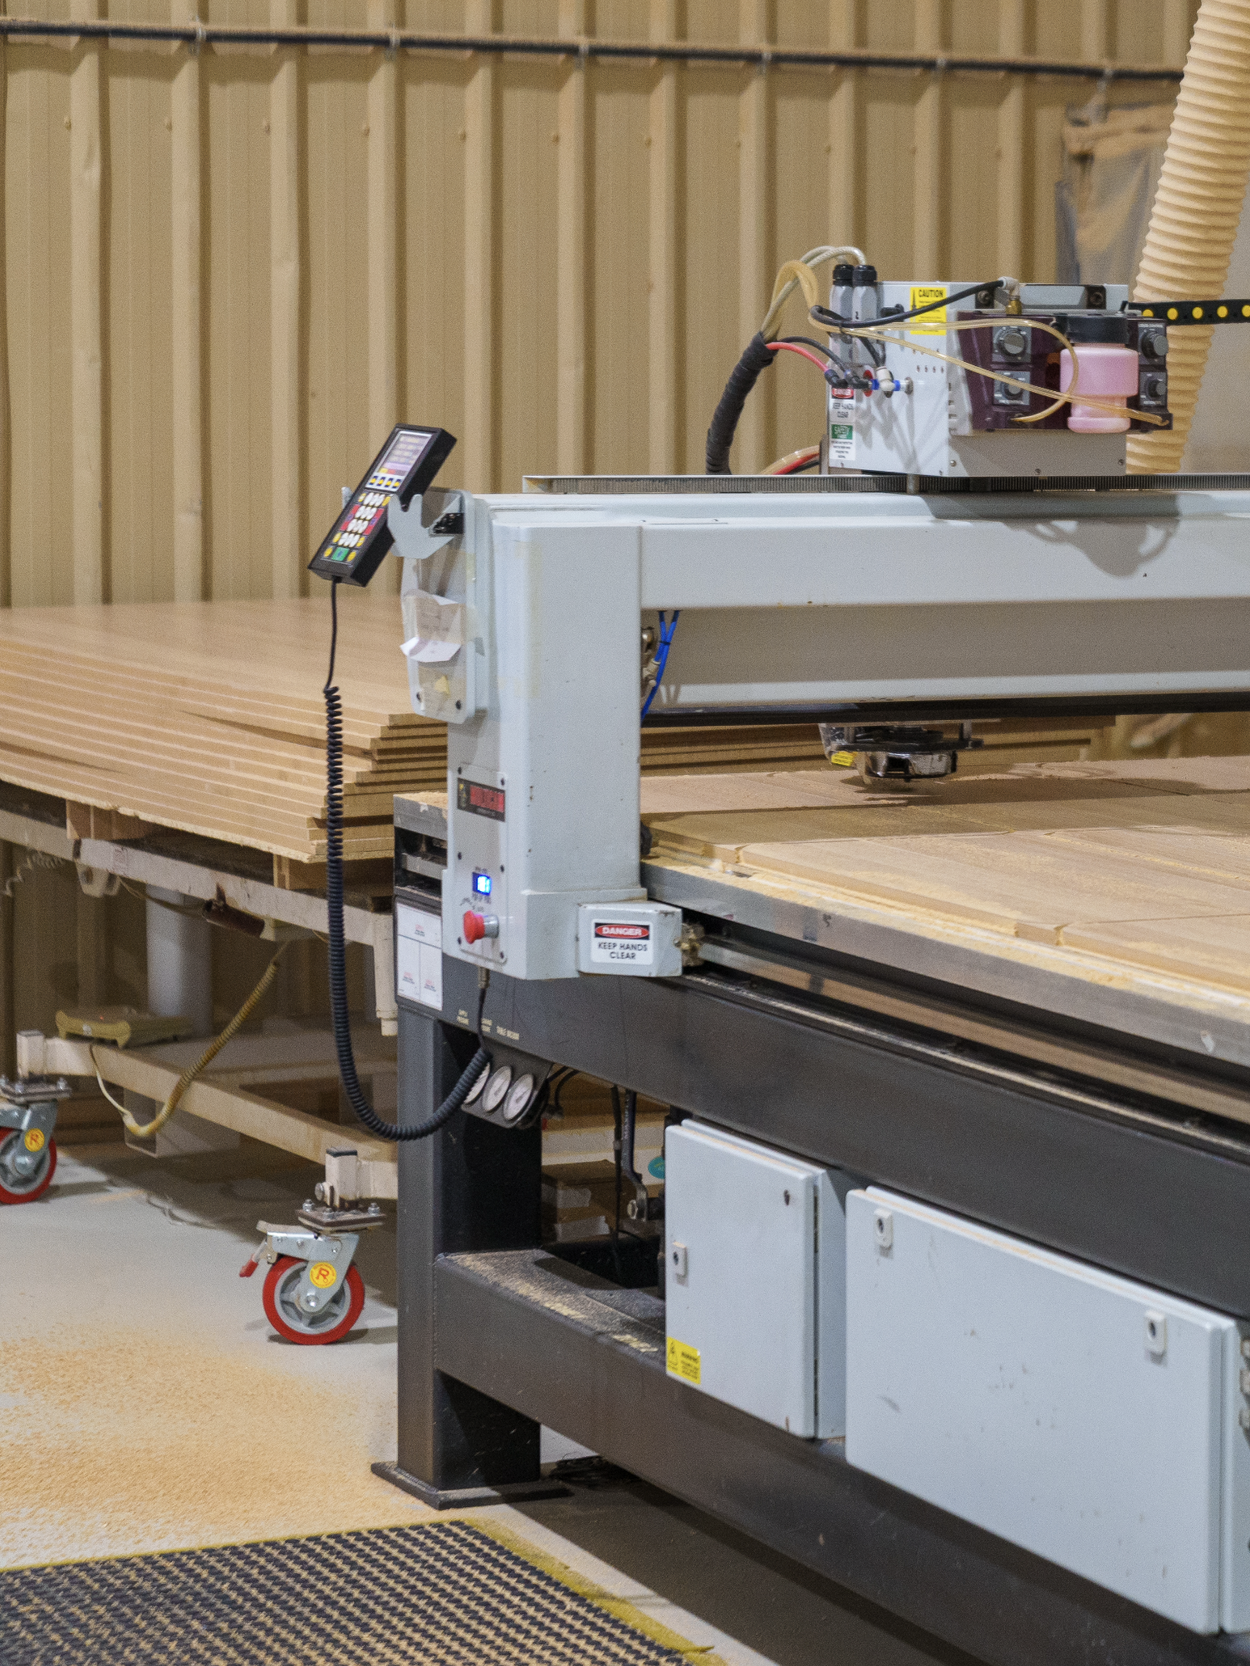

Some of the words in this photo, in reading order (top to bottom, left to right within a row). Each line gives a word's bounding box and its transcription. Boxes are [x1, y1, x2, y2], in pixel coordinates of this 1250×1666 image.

[918, 289, 944, 298] CAUTION
[602, 926, 642, 936] DANGER
[598, 942, 617, 950] KEEP
[619, 943, 648, 952] HANDS
[609, 951, 636, 960] CLEAR
